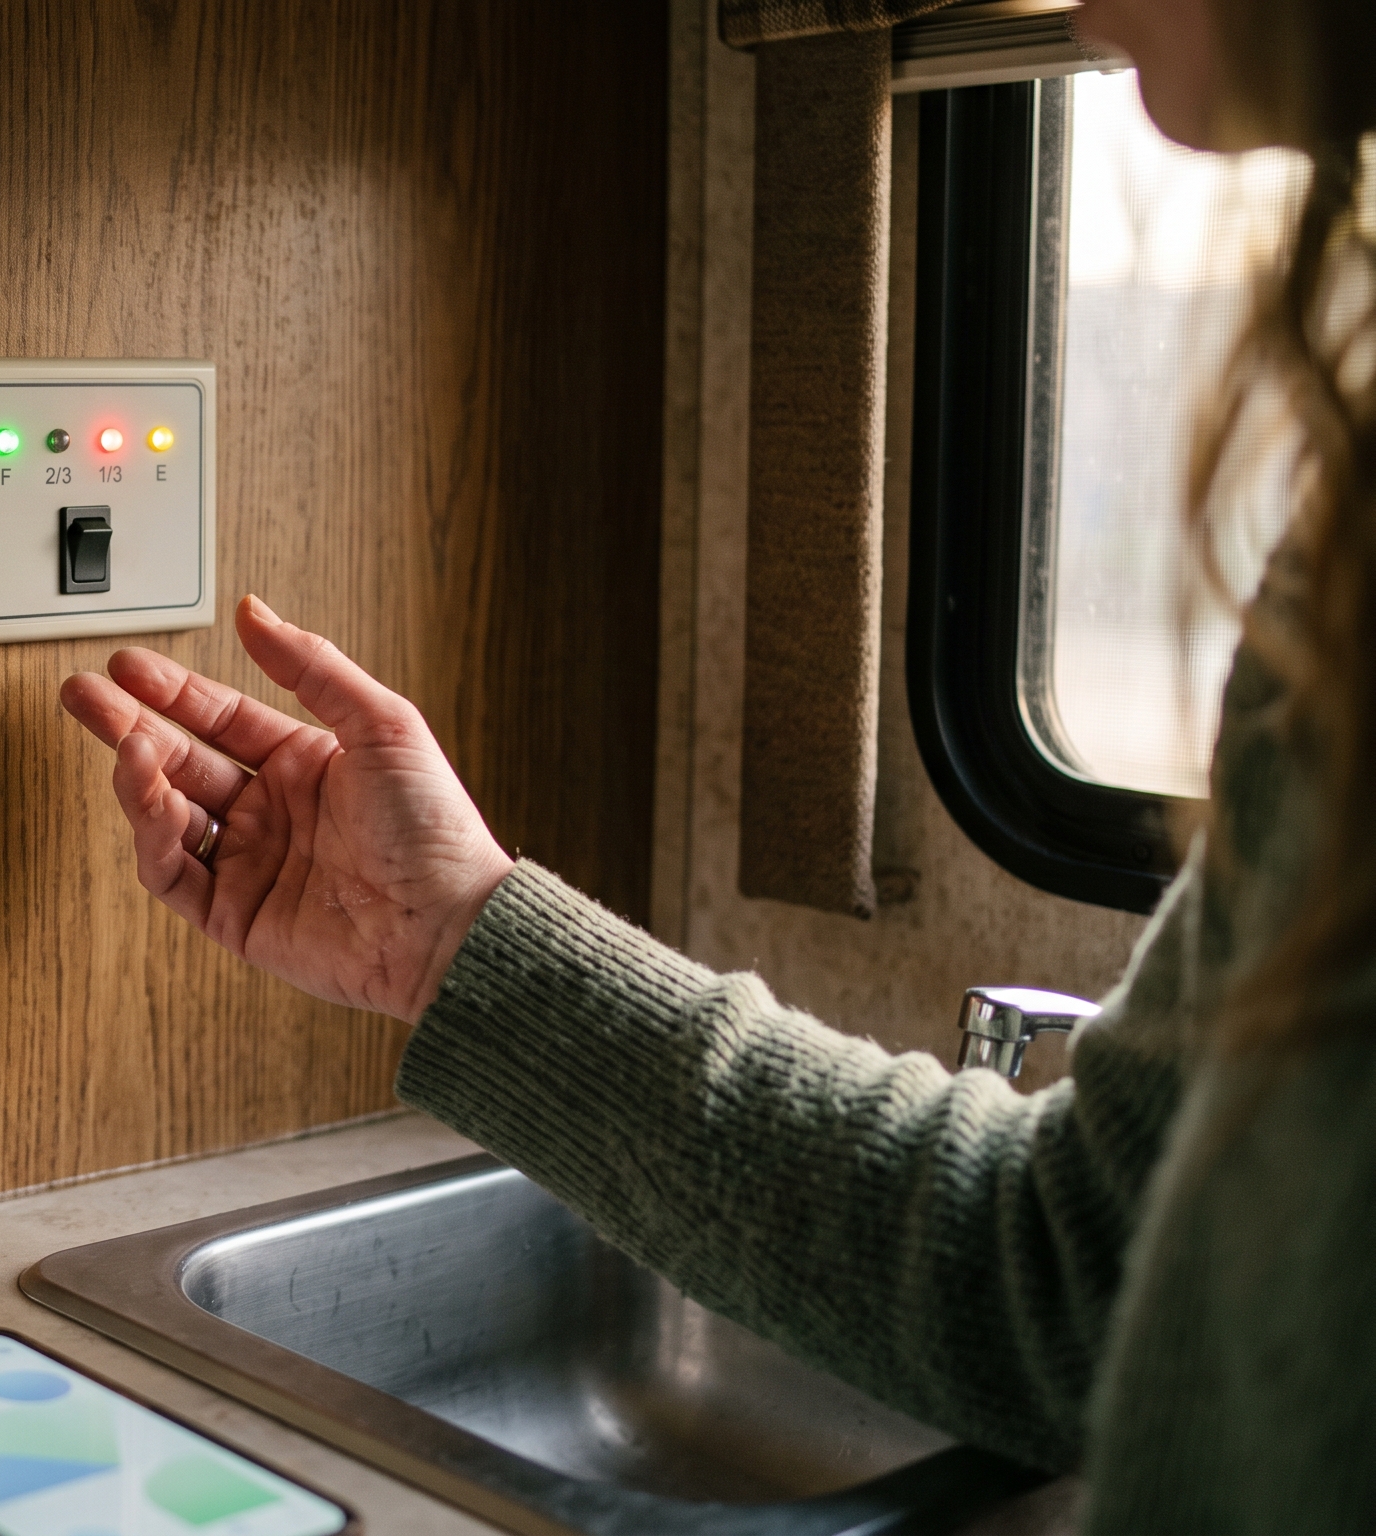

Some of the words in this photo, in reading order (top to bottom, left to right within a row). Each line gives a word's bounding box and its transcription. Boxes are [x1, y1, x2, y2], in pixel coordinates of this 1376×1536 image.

[1, 468, 12, 485] F
[45, 467, 72, 485] 2/3
[99, 465, 122, 483] 1/3
[156, 464, 167, 481] E
